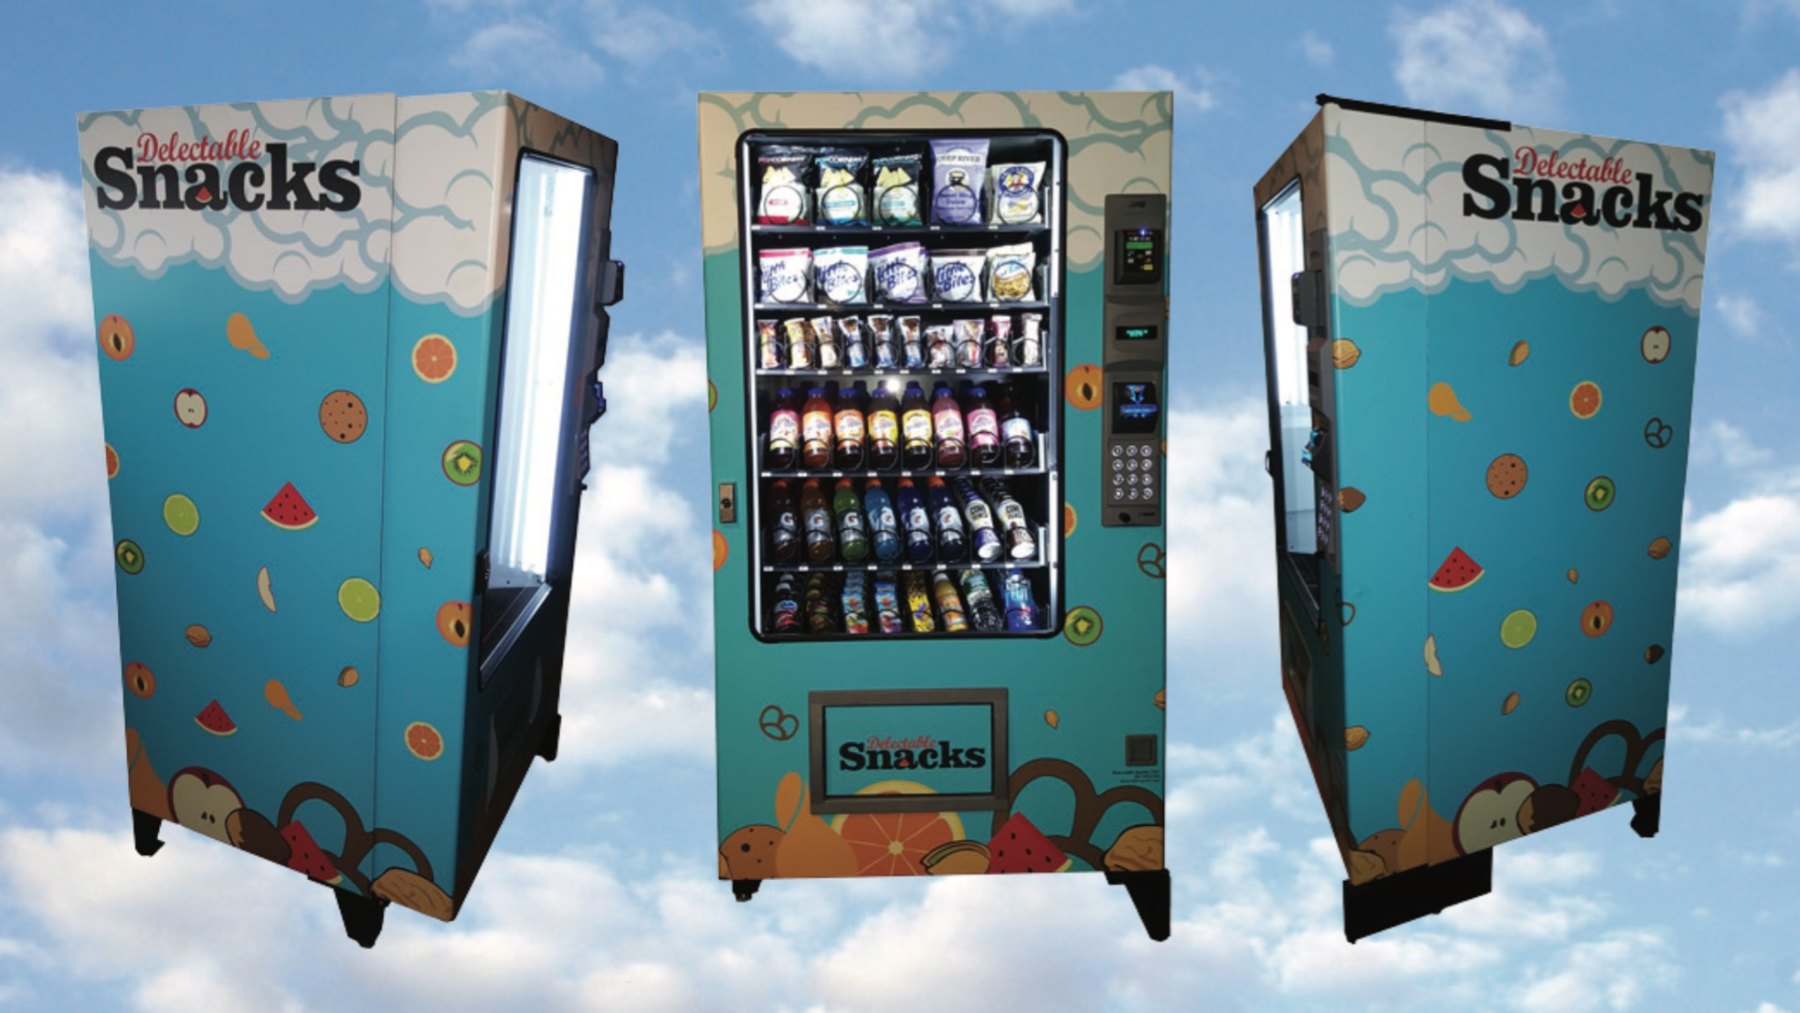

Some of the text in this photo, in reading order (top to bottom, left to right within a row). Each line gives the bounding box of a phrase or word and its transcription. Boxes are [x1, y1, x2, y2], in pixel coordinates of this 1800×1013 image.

[136, 128, 262, 163] Delectable
[94, 142, 361, 212] Snacks
[1513, 146, 1633, 185] Delectable
[1462, 153, 1704, 232] Snacks
[780, 511, 795, 526] G
[844, 511, 860, 526] G
[839, 740, 986, 772] Snacks
[866, 735, 937, 750] Delectable
